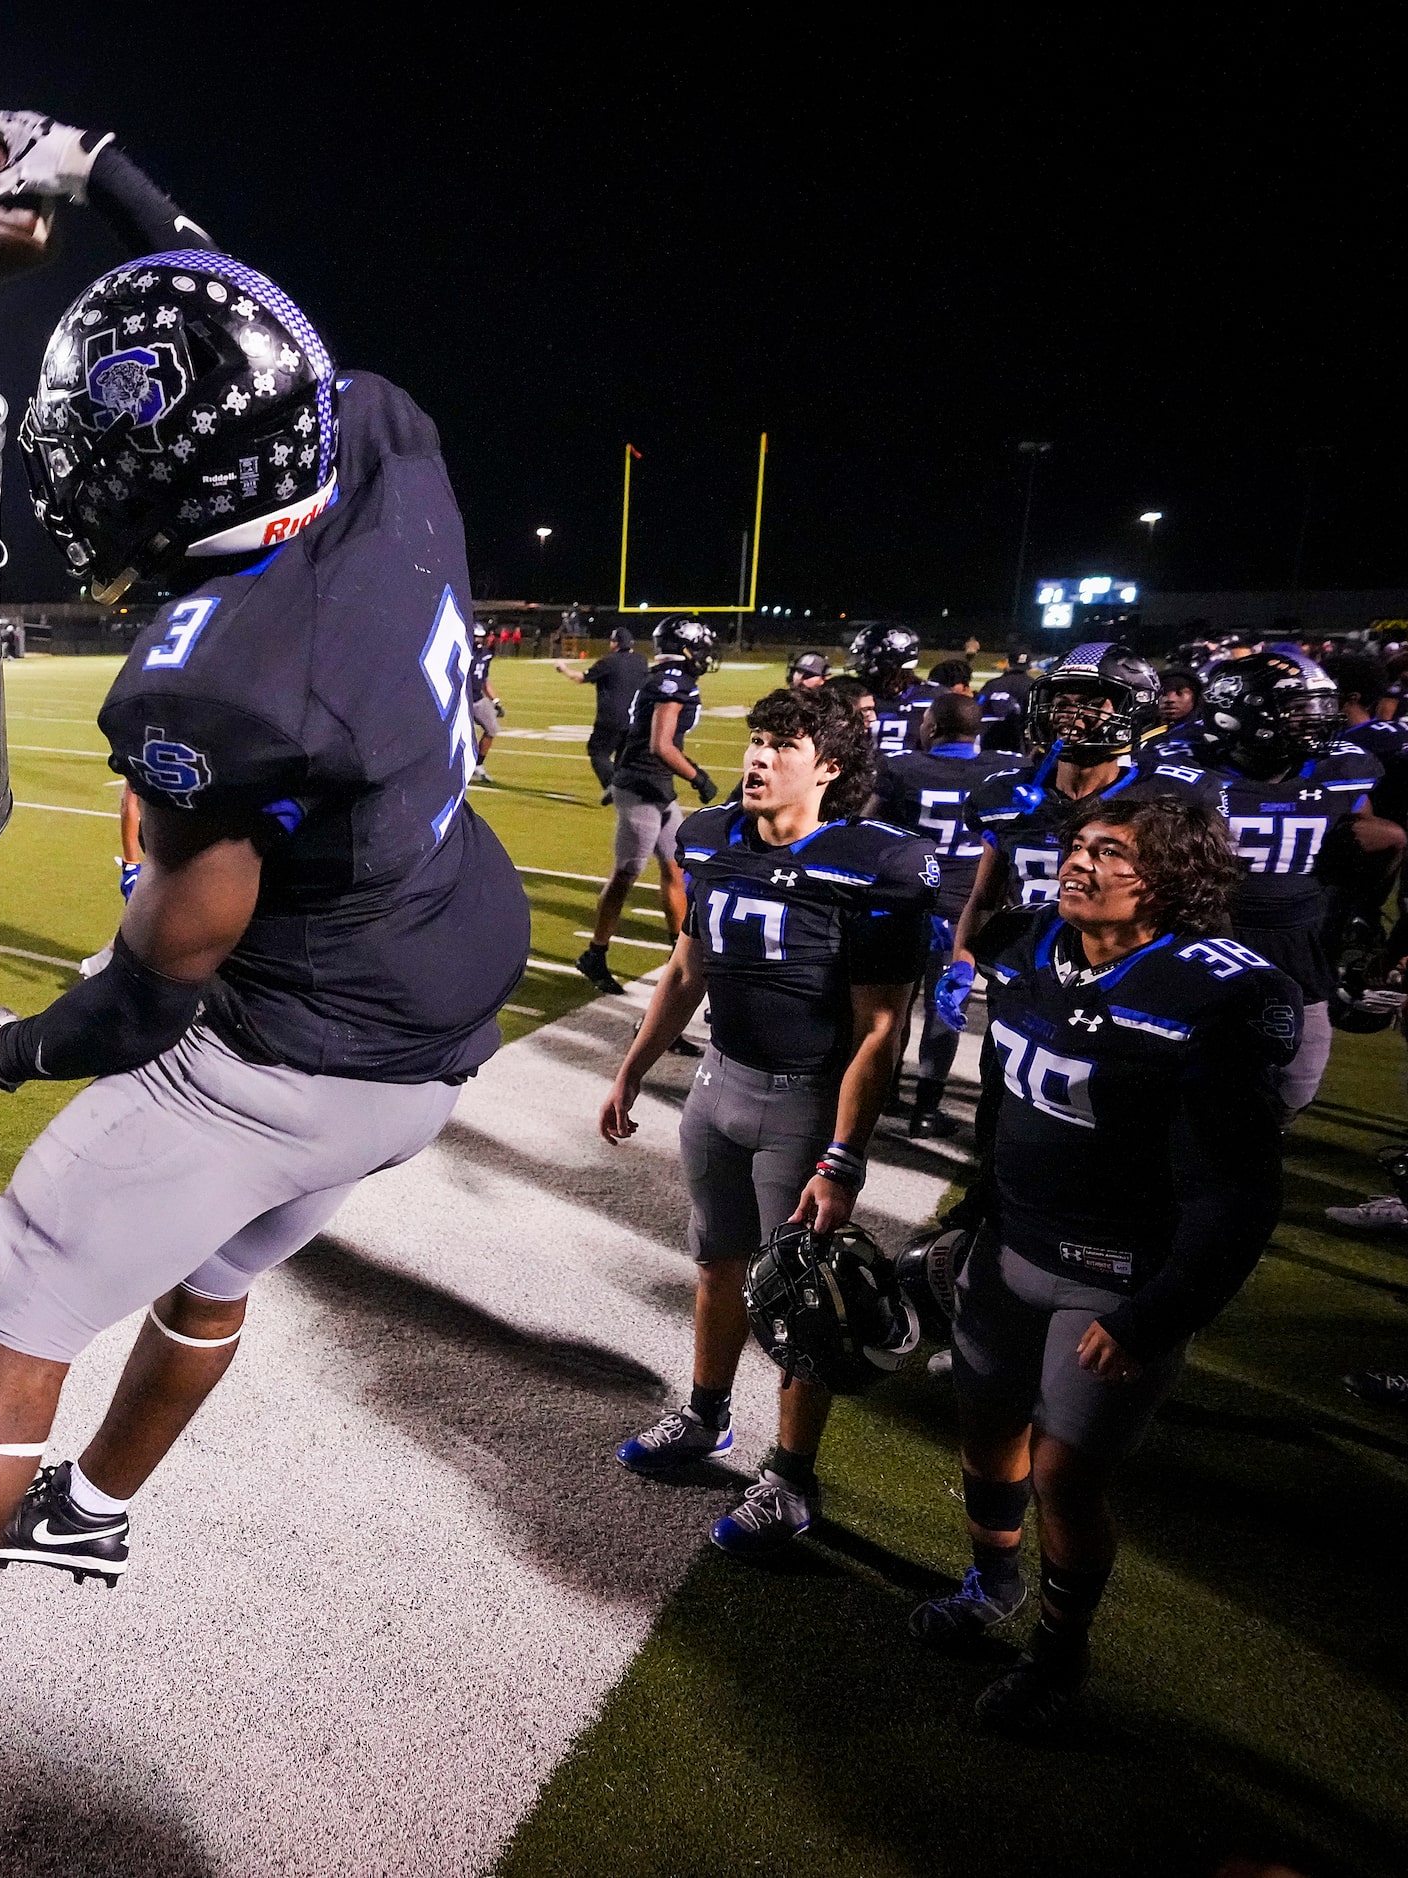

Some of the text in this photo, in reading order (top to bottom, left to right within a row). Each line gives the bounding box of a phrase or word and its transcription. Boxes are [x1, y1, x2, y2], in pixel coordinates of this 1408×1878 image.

[143, 596, 221, 670] 3
[143, 741, 200, 792] S
[918, 789, 985, 857] 5
[707, 889, 788, 961] 17
[1174, 936, 1278, 982] 38
